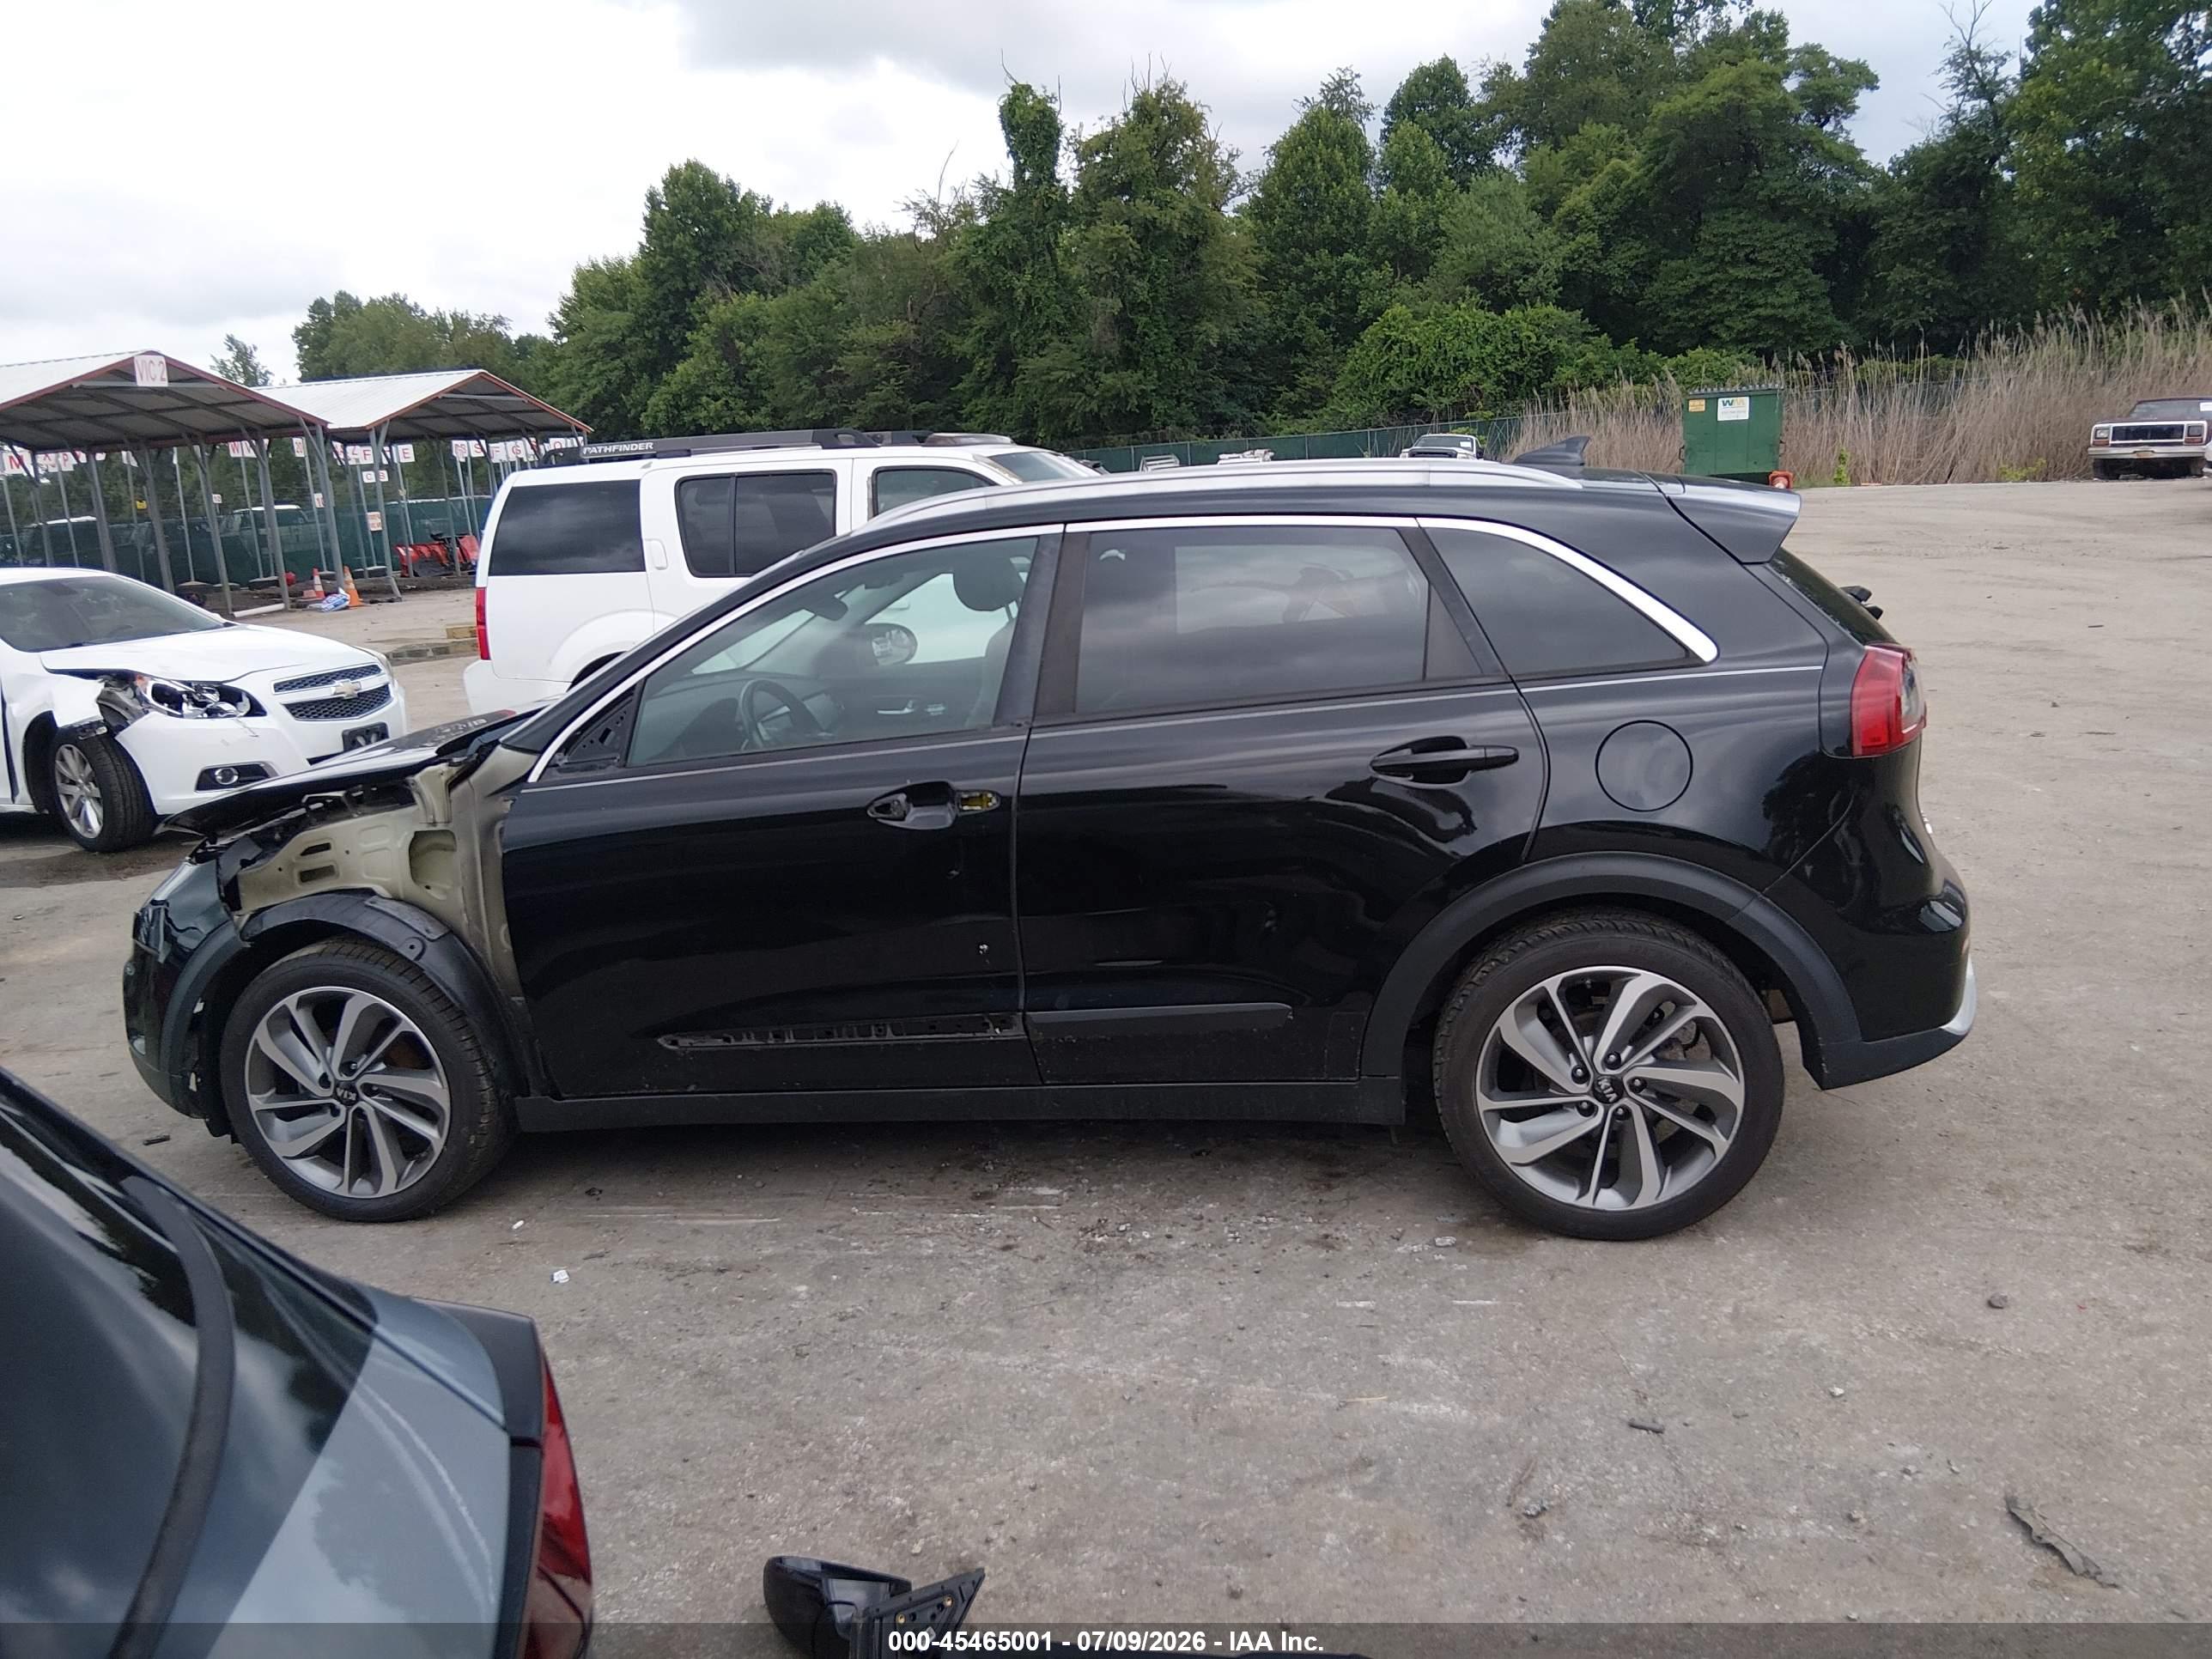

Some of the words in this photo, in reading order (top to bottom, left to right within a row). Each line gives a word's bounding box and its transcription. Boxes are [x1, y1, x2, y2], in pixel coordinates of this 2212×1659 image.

[137, 359, 157, 382] VIC
[158, 360, 167, 382] 2
[363, 449, 371, 460] F
[402, 448, 411, 459] E
[583, 442, 653, 455] PATHFINDER
[336, 1087, 356, 1102] KIA
[1598, 1079, 1618, 1103] KIA
